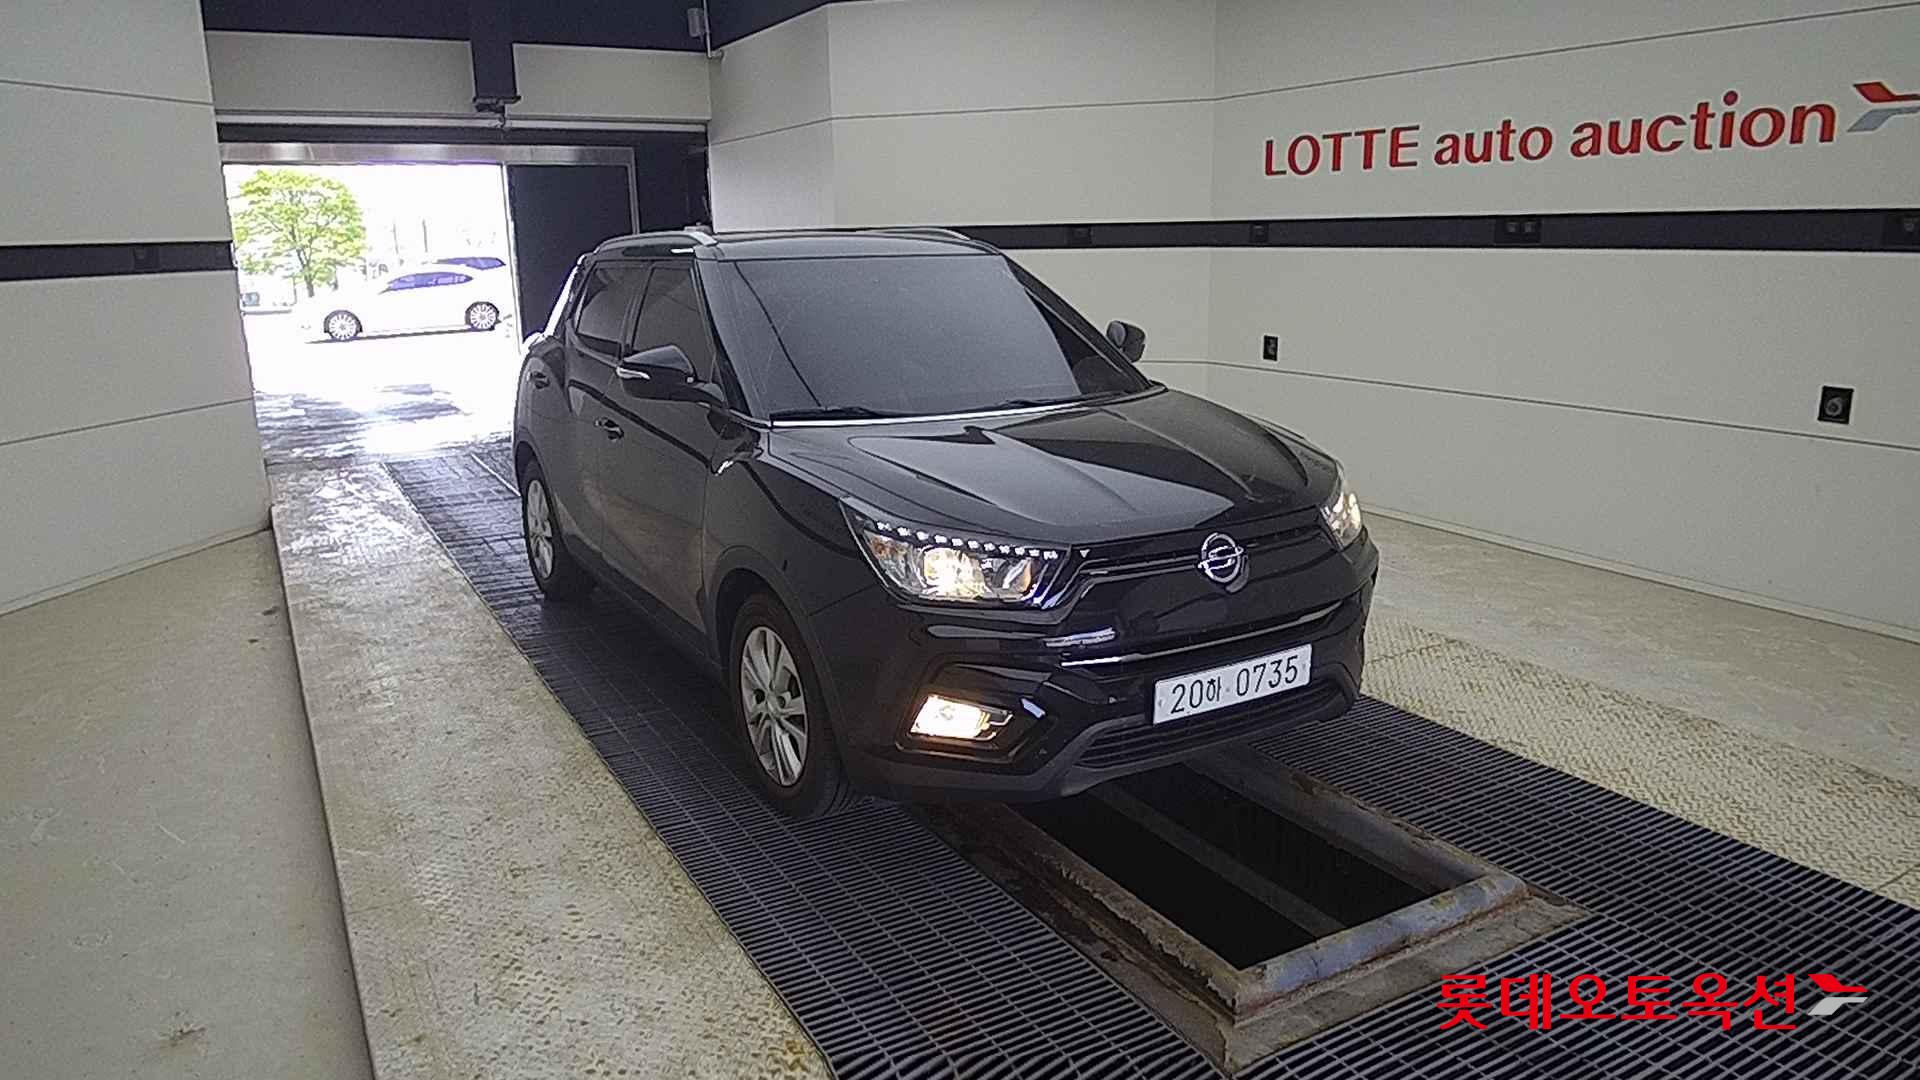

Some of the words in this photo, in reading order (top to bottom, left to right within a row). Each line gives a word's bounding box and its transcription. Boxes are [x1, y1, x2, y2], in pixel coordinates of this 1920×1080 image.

[1265, 125, 1420, 175] LOTTE
[1434, 119, 1553, 165] auto
[1570, 90, 1836, 158] auction
[1170, 676, 1222, 714] 20하
[1236, 655, 1298, 696] 0735
